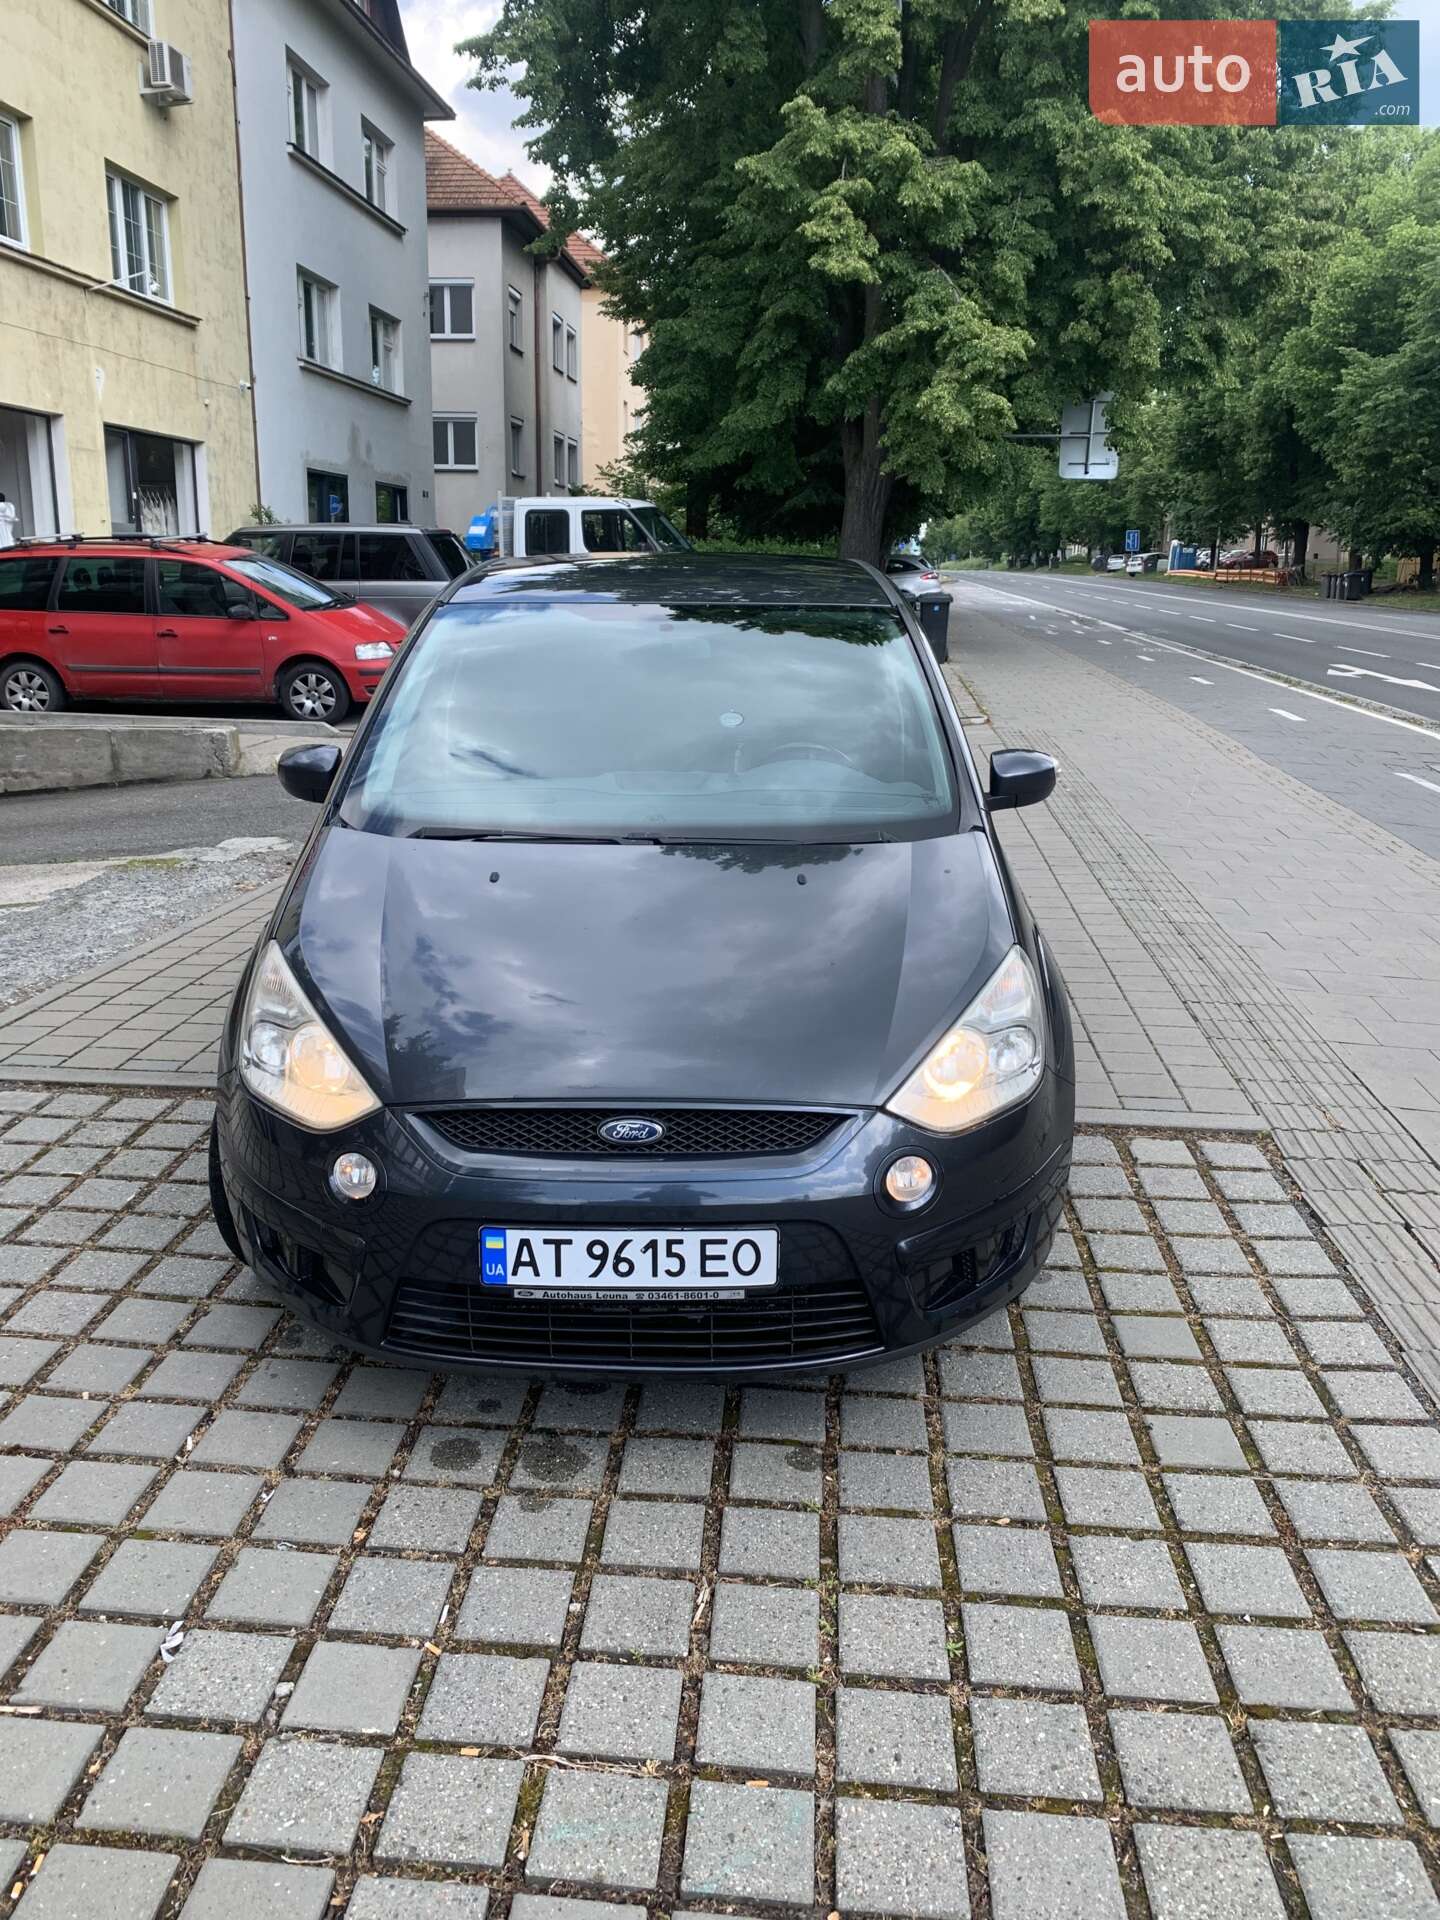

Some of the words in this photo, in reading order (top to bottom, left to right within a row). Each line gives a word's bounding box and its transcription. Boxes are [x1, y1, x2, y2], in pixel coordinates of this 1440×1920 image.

[613, 1123, 649, 1139] Ford
[511, 1238, 573, 1277] AT
[586, 1238, 686, 1278] 9615
[700, 1238, 762, 1277] EO
[486, 1263, 505, 1276] UA
[542, 1291, 592, 1300] Autohaus
[596, 1291, 628, 1300] Leuna
[647, 1291, 719, 1300] 03461-8601-0
